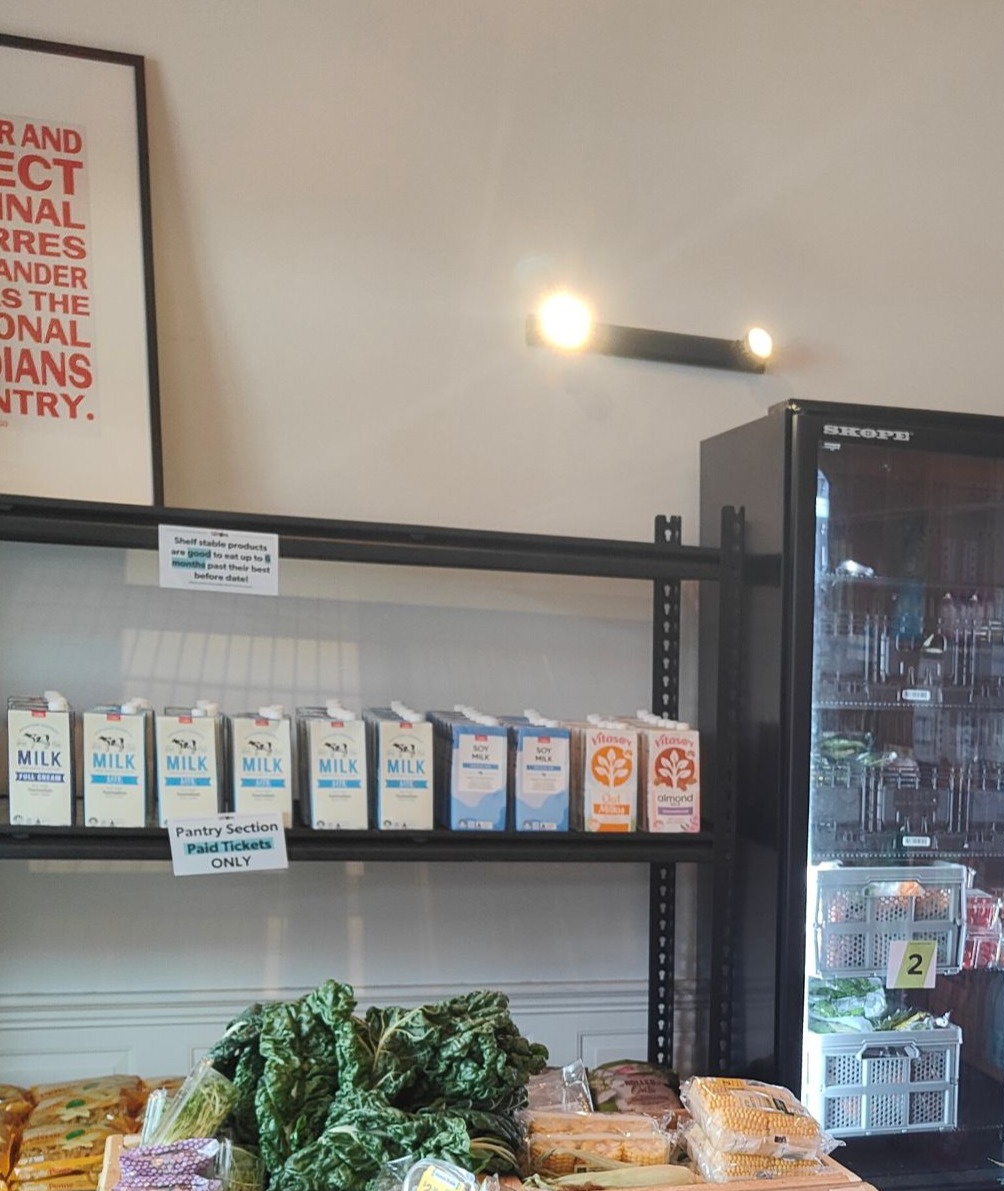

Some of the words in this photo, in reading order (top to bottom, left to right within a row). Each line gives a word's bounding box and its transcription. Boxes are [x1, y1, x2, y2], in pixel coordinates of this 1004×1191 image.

[21, 124, 82, 154] AND
[0, 151, 83, 195] ECT
[28, 290, 90, 316] THE
[0, 346, 92, 389] IANS
[823, 424, 910, 441] SKOPE
[174, 536, 197, 546] Shelf
[199, 539, 226, 549] stable
[228, 541, 267, 552] products
[187, 549, 211, 559] good
[213, 550, 222, 559] to
[224, 552, 238, 560] eat
[240, 553, 252, 563] up
[253, 554, 263, 562] to
[172, 560, 206, 569] months
[207, 562, 227, 571] past
[229, 563, 249, 572] their
[251, 565, 270, 574] best
[194, 572, 223, 581] before
[225, 574, 249, 583] date!
[17, 750, 62, 767] MILK
[93, 753, 135, 769] MILK
[166, 755, 208, 771] MILK
[242, 757, 283, 772] MILK
[319, 759, 358, 774] MILK
[387, 759, 425, 774] MILK
[657, 794, 694, 803] almond
[176, 826, 222, 838] Pantry
[226, 821, 279, 835] Section
[187, 842, 218, 854] Paid
[221, 839, 272, 853] Tickets
[211, 856, 251, 869] ONLY
[907, 953, 923, 976] 2
